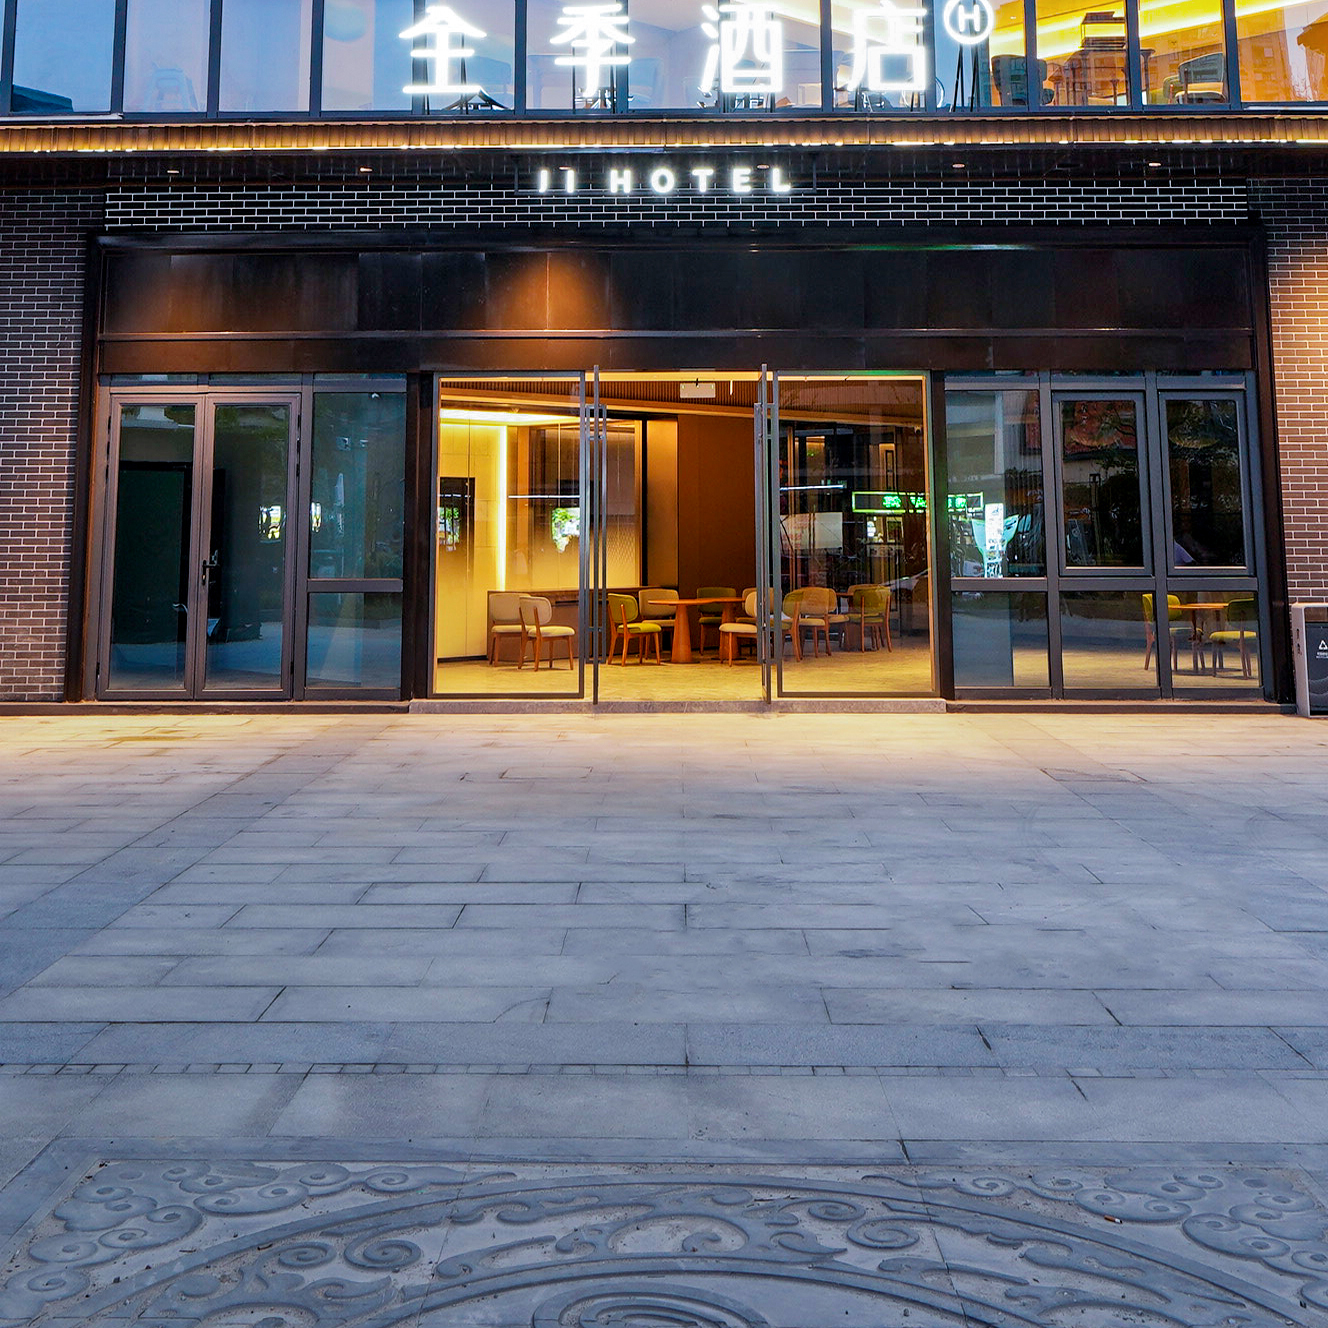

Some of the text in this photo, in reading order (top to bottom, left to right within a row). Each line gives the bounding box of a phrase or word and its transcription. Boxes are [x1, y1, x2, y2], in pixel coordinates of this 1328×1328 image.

[399, 2, 928, 97] 全季酒店
[538, 167, 792, 194] JI HOTEL
